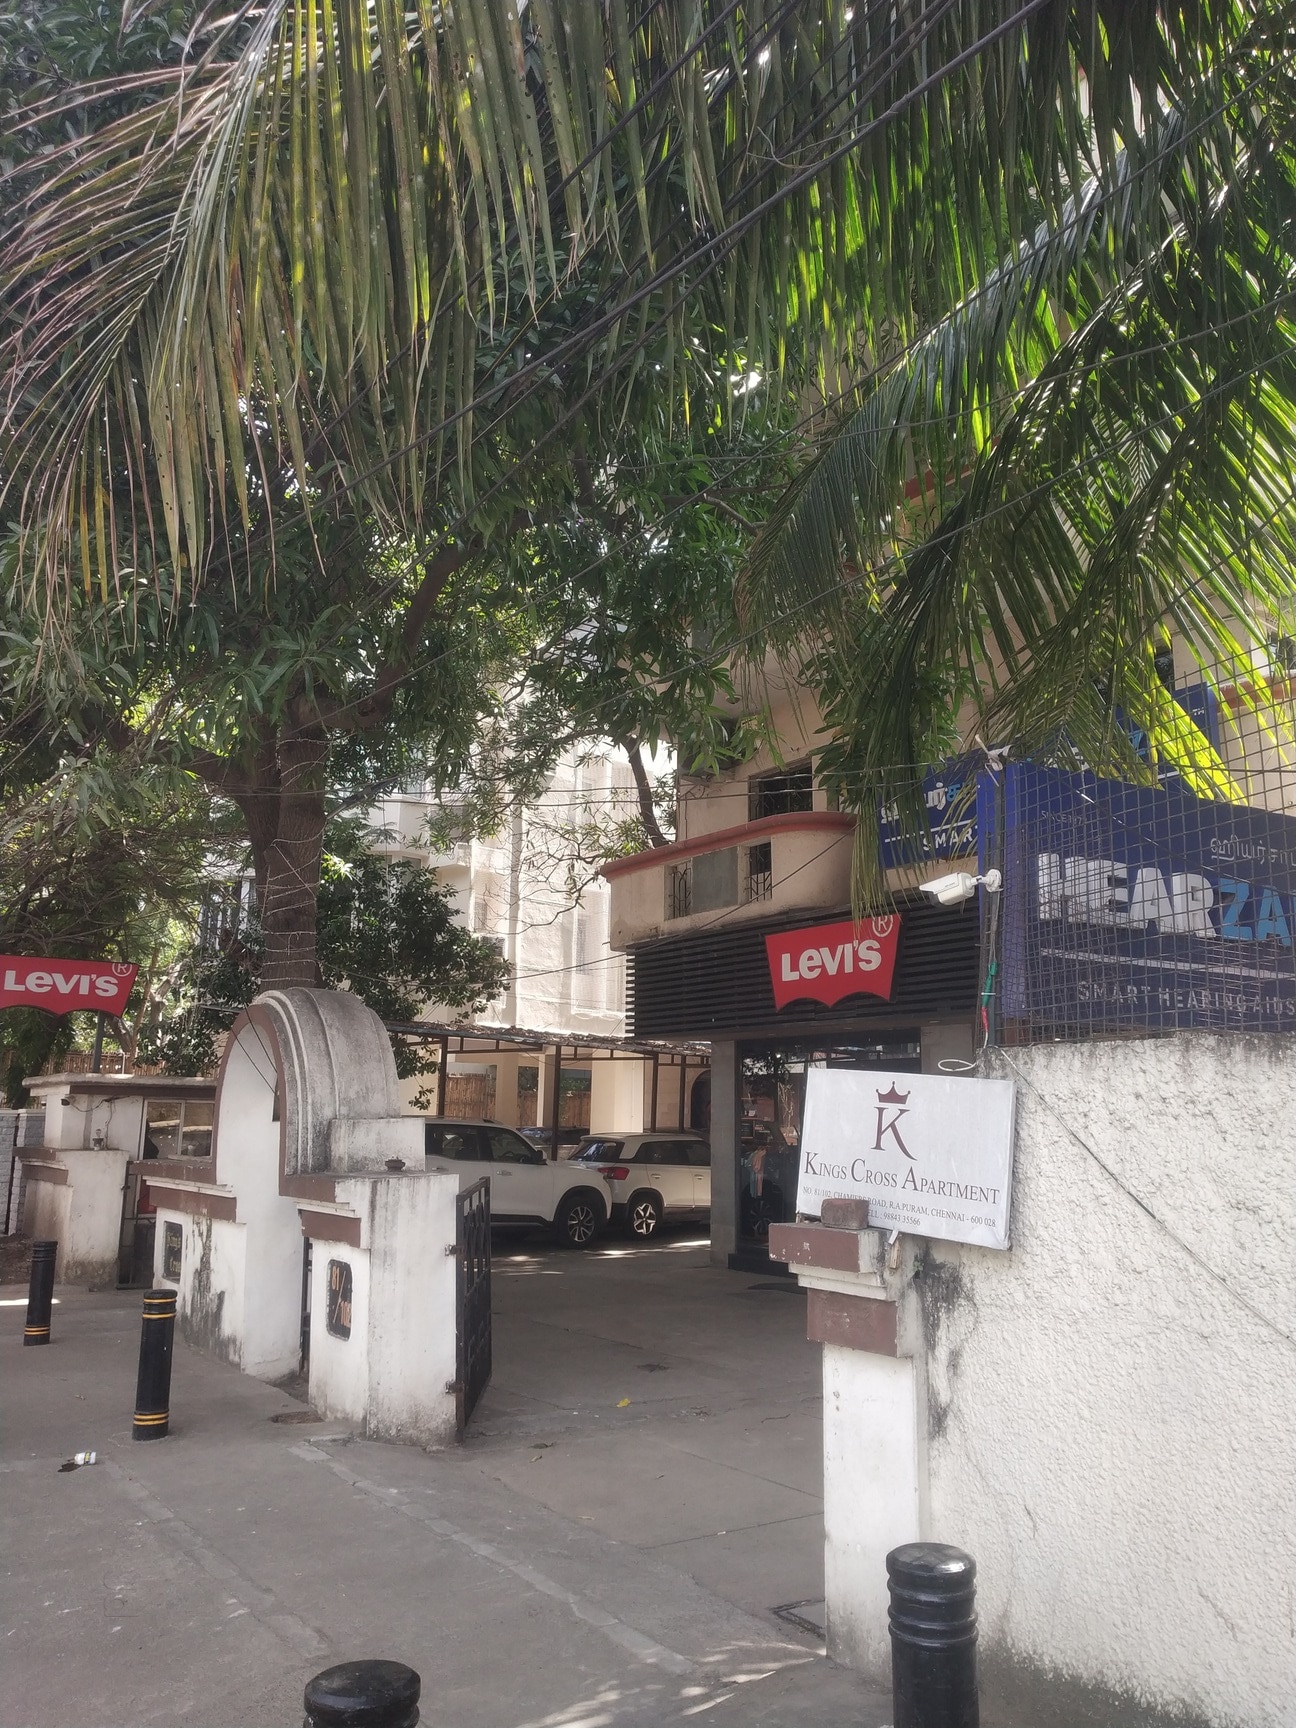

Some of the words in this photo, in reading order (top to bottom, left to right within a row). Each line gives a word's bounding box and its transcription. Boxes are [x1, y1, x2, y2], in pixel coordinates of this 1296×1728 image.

[922, 826, 978, 851] SMAR
[1038, 852, 1296, 947] HEARZA
[1077, 980, 1151, 1005] SMART
[1158, 986, 1248, 1017] HEARING
[871, 1106, 918, 1161] K
[804, 1151, 847, 1181] KINGS
[851, 1158, 898, 1188] CROSS
[902, 1165, 1000, 1205] APARTMENT
[884, 1212, 900, 1222] 98843
[902, 1215, 921, 1226] 35566
[931, 1208, 965, 1222] CHENNAI
[970, 1215, 983, 1225] 600
[984, 1217, 996, 1228] 028
